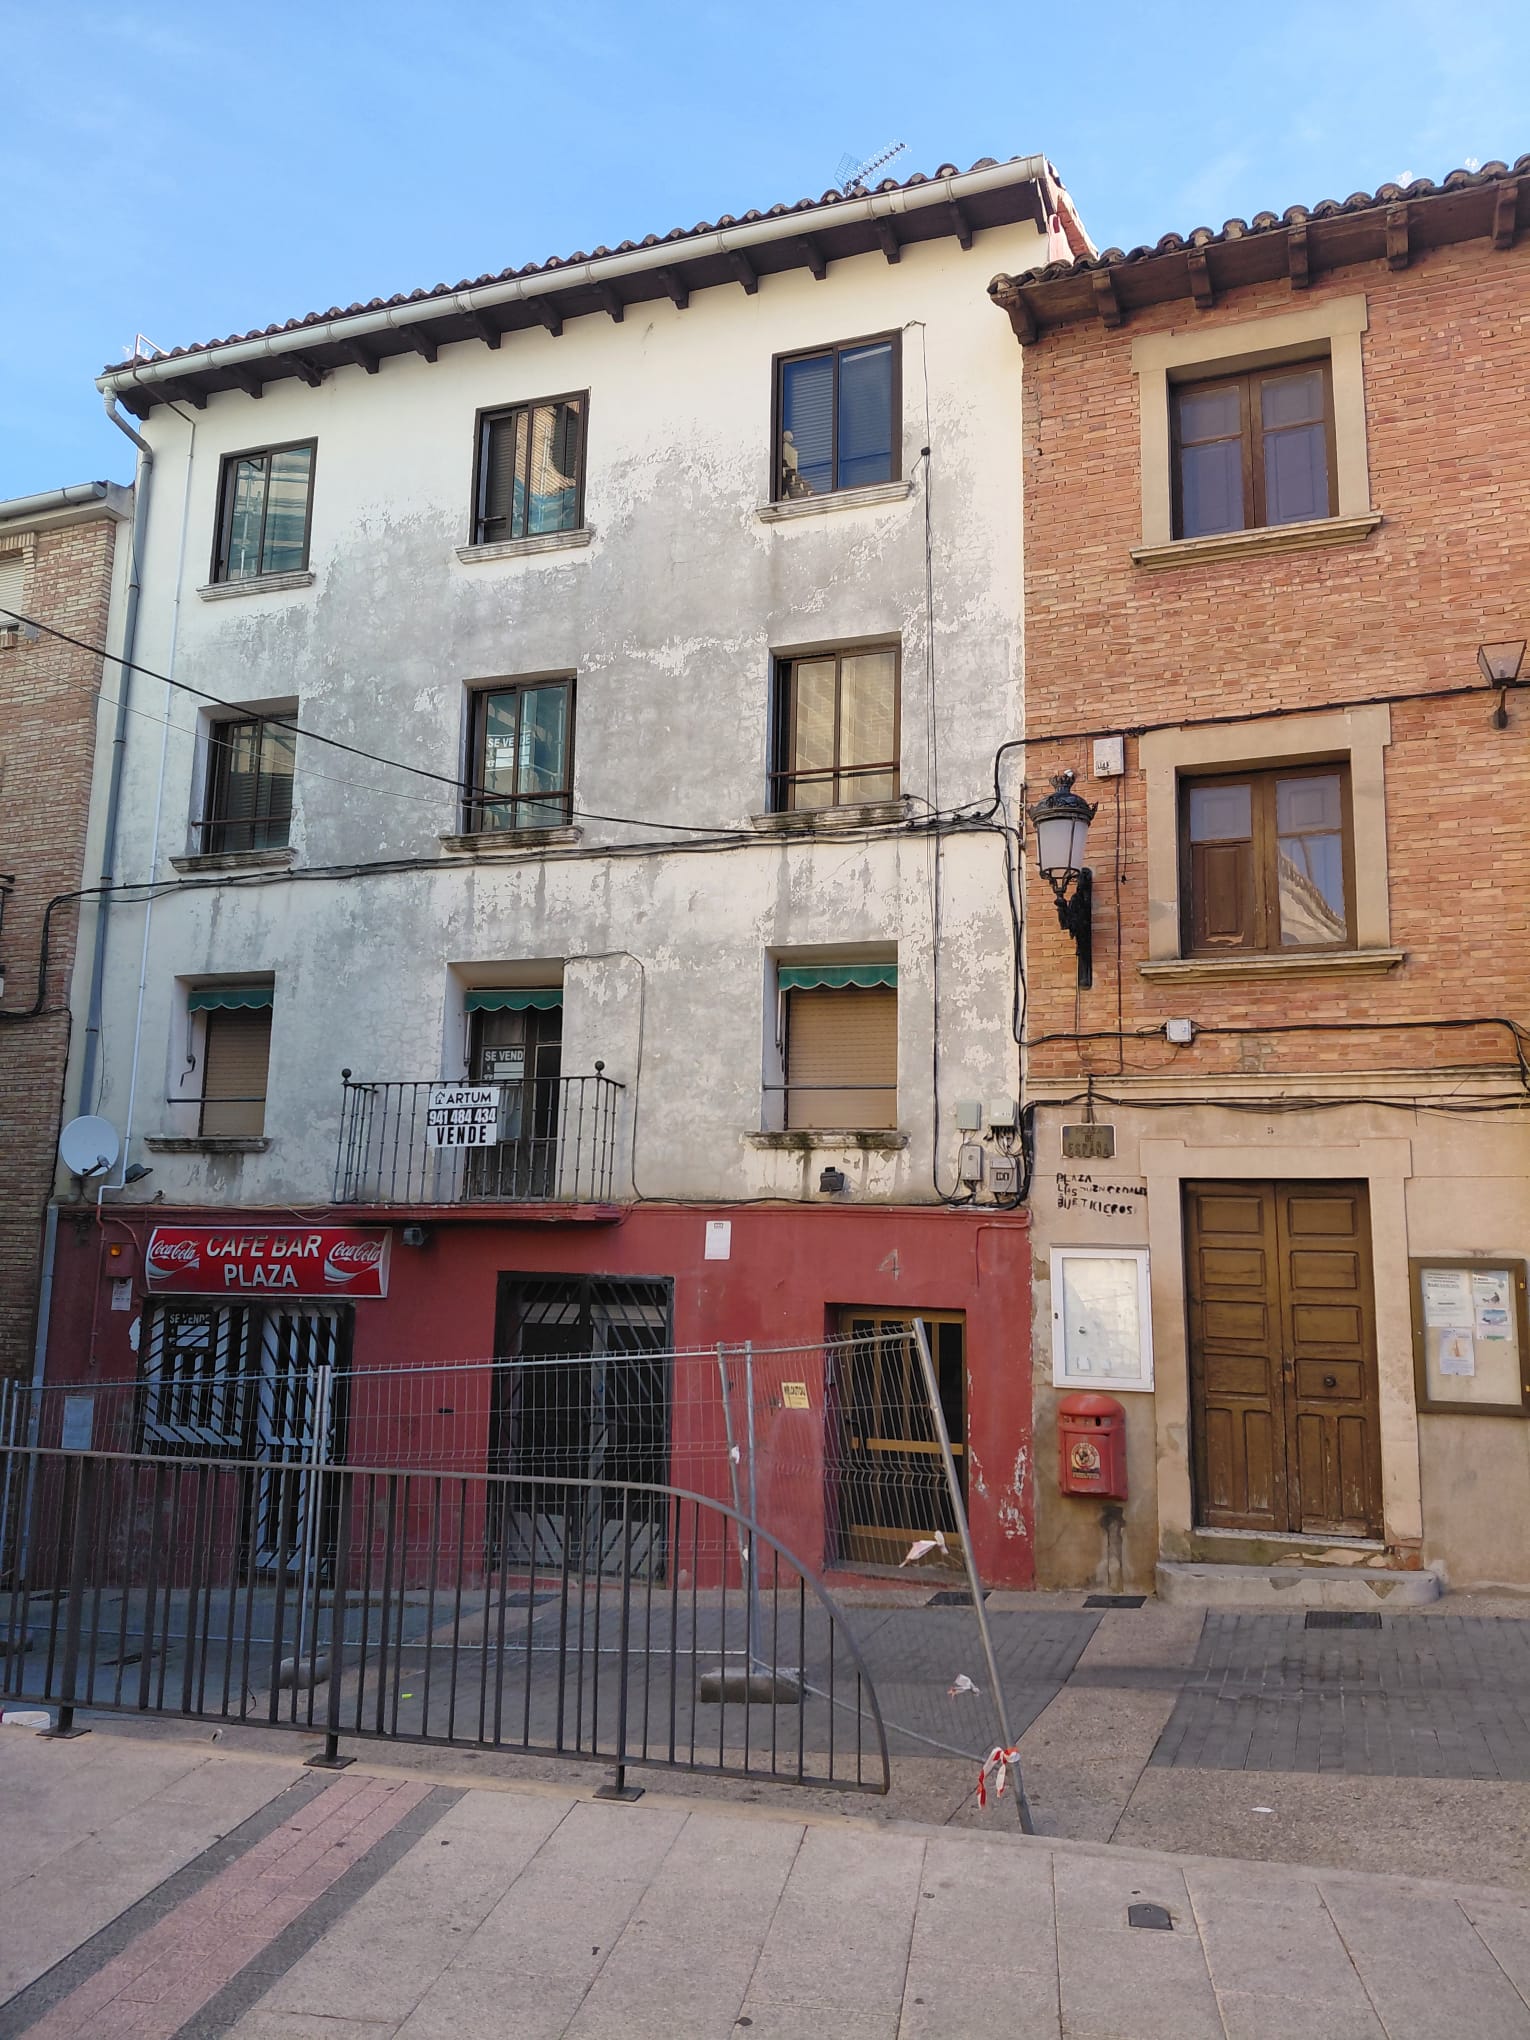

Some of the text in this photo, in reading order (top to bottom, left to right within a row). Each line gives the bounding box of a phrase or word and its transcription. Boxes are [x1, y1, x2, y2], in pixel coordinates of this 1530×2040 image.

[488, 734, 530, 748] SE VEDE
[485, 1051, 497, 1061] SE
[446, 1091, 491, 1104] ARTUM
[429, 1107, 496, 1125] 941 484 434
[437, 1125, 487, 1145] VENDE
[1075, 1127, 1103, 1135] PLAZA
[1084, 1134, 1095, 1143] DE
[1067, 1141, 1111, 1156] ESPAÑA
[1056, 1172, 1092, 1184] PLAZA
[206, 1234, 322, 1258] CAFE BAR
[877, 1248, 900, 1280] 4
[224, 1263, 299, 1288] PLAZA
[169, 1313, 181, 1324] SE
